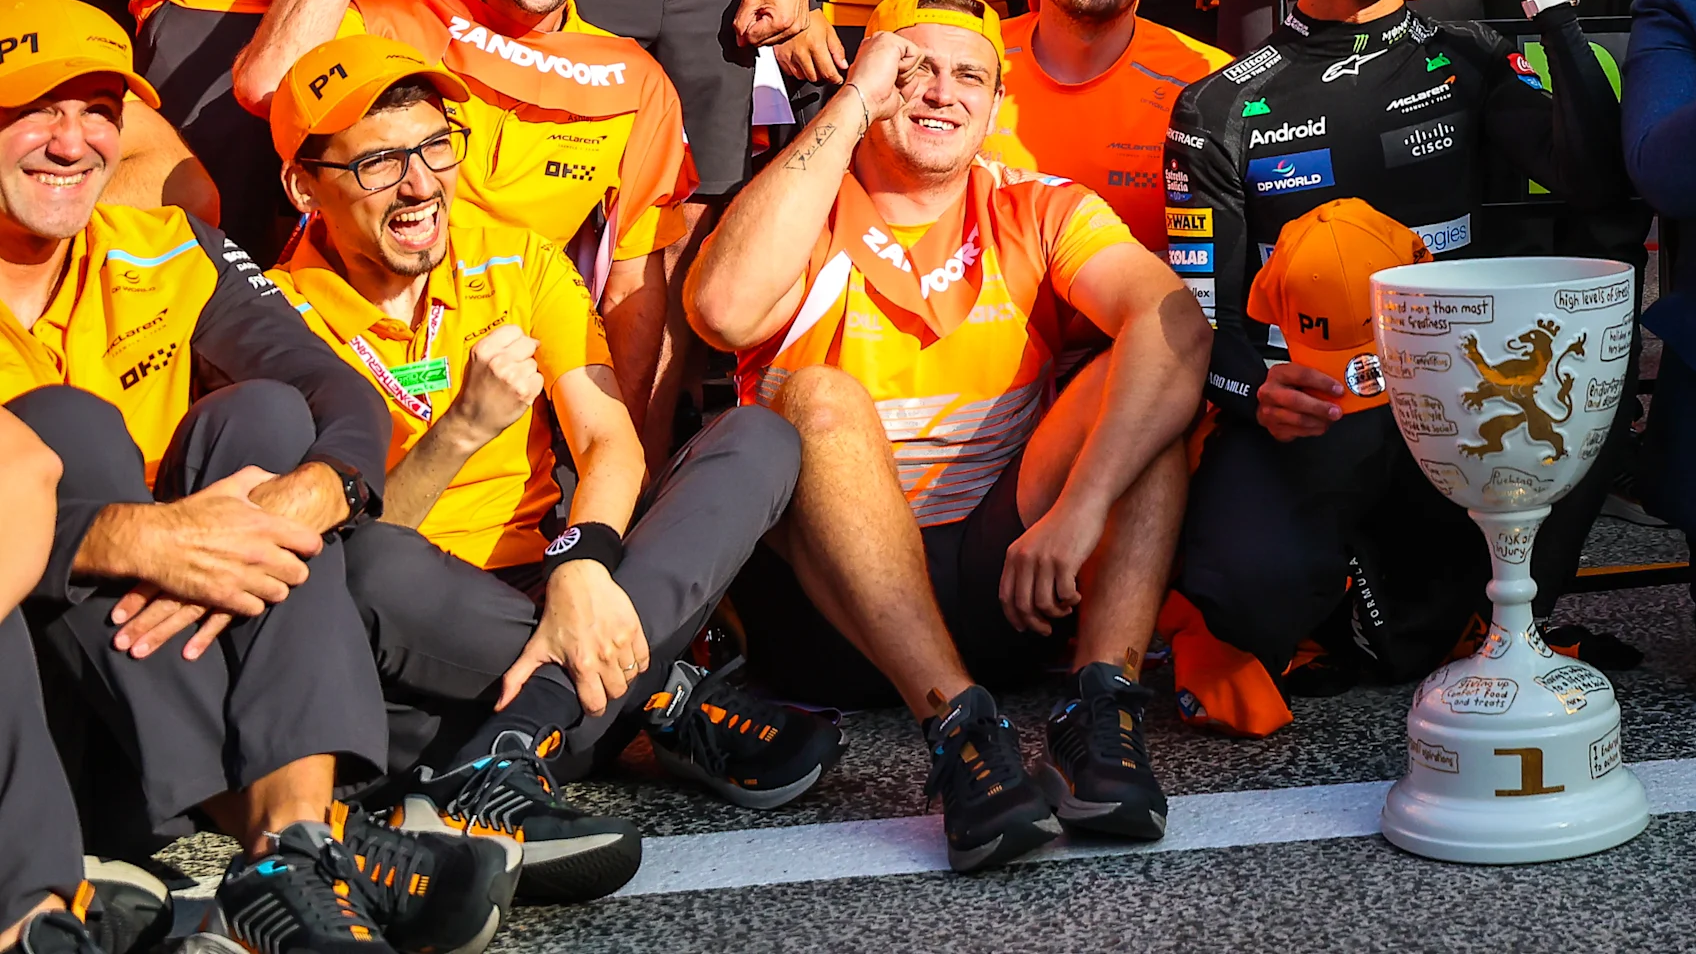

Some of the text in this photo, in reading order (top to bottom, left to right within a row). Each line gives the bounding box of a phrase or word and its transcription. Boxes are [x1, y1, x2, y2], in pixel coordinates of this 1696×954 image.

[0, 32, 39, 64] P1
[449, 15, 627, 87] ZANDVOORT
[1226, 46, 1273, 79] Hilton
[1236, 54, 1283, 85] FOR THE STAY
[309, 62, 349, 101] P1
[1386, 75, 1456, 112] McLaren
[567, 112, 594, 123] Ashley
[546, 134, 608, 145] McLaren
[1166, 128, 1205, 149] RKTRACE
[1249, 116, 1327, 149] Android
[1411, 137, 1453, 157] CISCO
[544, 161, 596, 182] OKX
[1108, 170, 1158, 188] OKX
[1165, 169, 1189, 183] Estrella
[1257, 173, 1322, 193] DP WORLD
[1167, 214, 1206, 230] WALT
[1169, 250, 1208, 266] COLAB
[1433, 299, 1458, 315] than
[1461, 299, 1489, 315] most
[1559, 289, 1615, 310] high levels of
[1298, 313, 1329, 340] P1
[119, 342, 177, 391] OKX
[1349, 556, 1384, 628] FORMULA
[1484, 687, 1508, 699] food
[1496, 680, 1510, 689] up
[1453, 697, 1505, 708] and treats
[1494, 747, 1565, 797] 1
